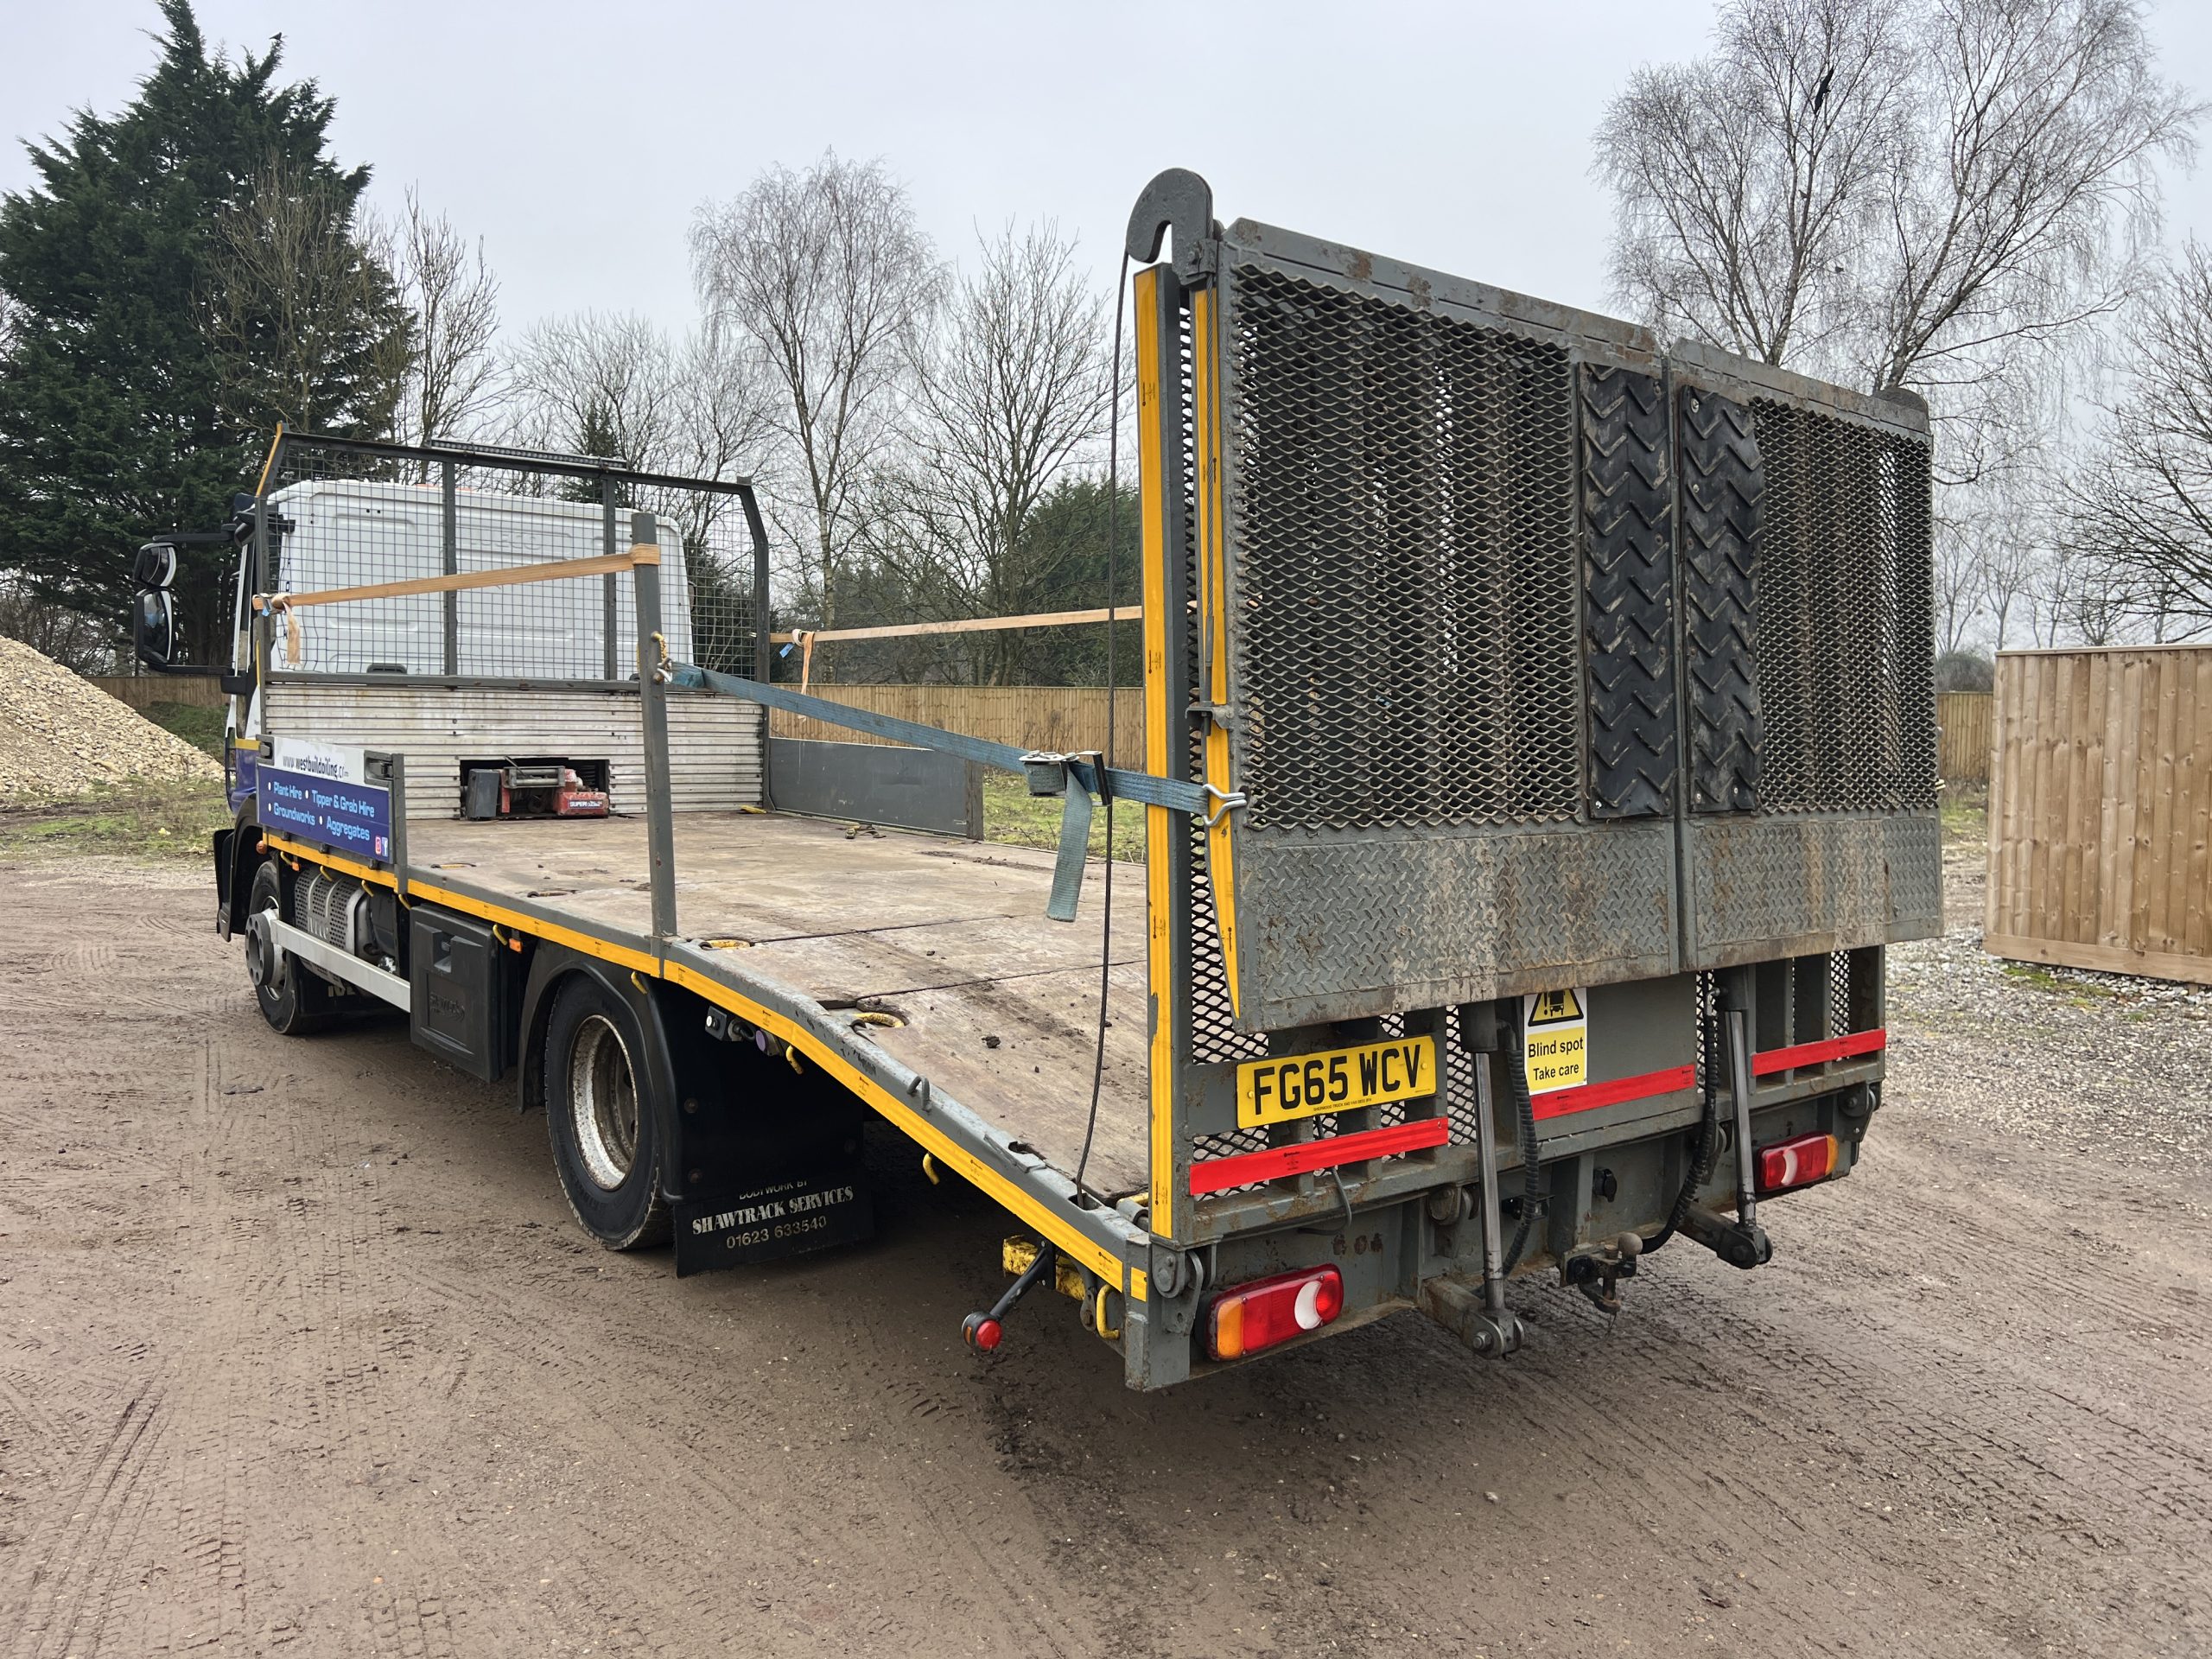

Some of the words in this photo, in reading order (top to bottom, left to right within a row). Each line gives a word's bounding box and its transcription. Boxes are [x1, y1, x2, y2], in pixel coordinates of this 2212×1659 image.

[273, 781, 289, 798] Plant
[289, 785, 302, 800] Hire
[312, 790, 333, 808] Tipper
[333, 795, 340, 808] &
[340, 797, 357, 813] Grab
[359, 802, 375, 817] Hire
[273, 803, 315, 826] Groundworks
[327, 816, 371, 841] Aggregates
[1529, 1039, 1557, 1058] Blind
[1560, 1037, 1583, 1055] spot
[1254, 1056, 1348, 1116] FG65
[1359, 1045, 1421, 1097] WCV
[1533, 1066, 1556, 1081] Take
[1559, 1064, 1580, 1077] care
[692, 1200, 787, 1235] SHAWTRACK
[788, 1185, 854, 1213] SERVICES
[726, 1228, 770, 1249] 01623
[774, 1215, 827, 1238] 633540
